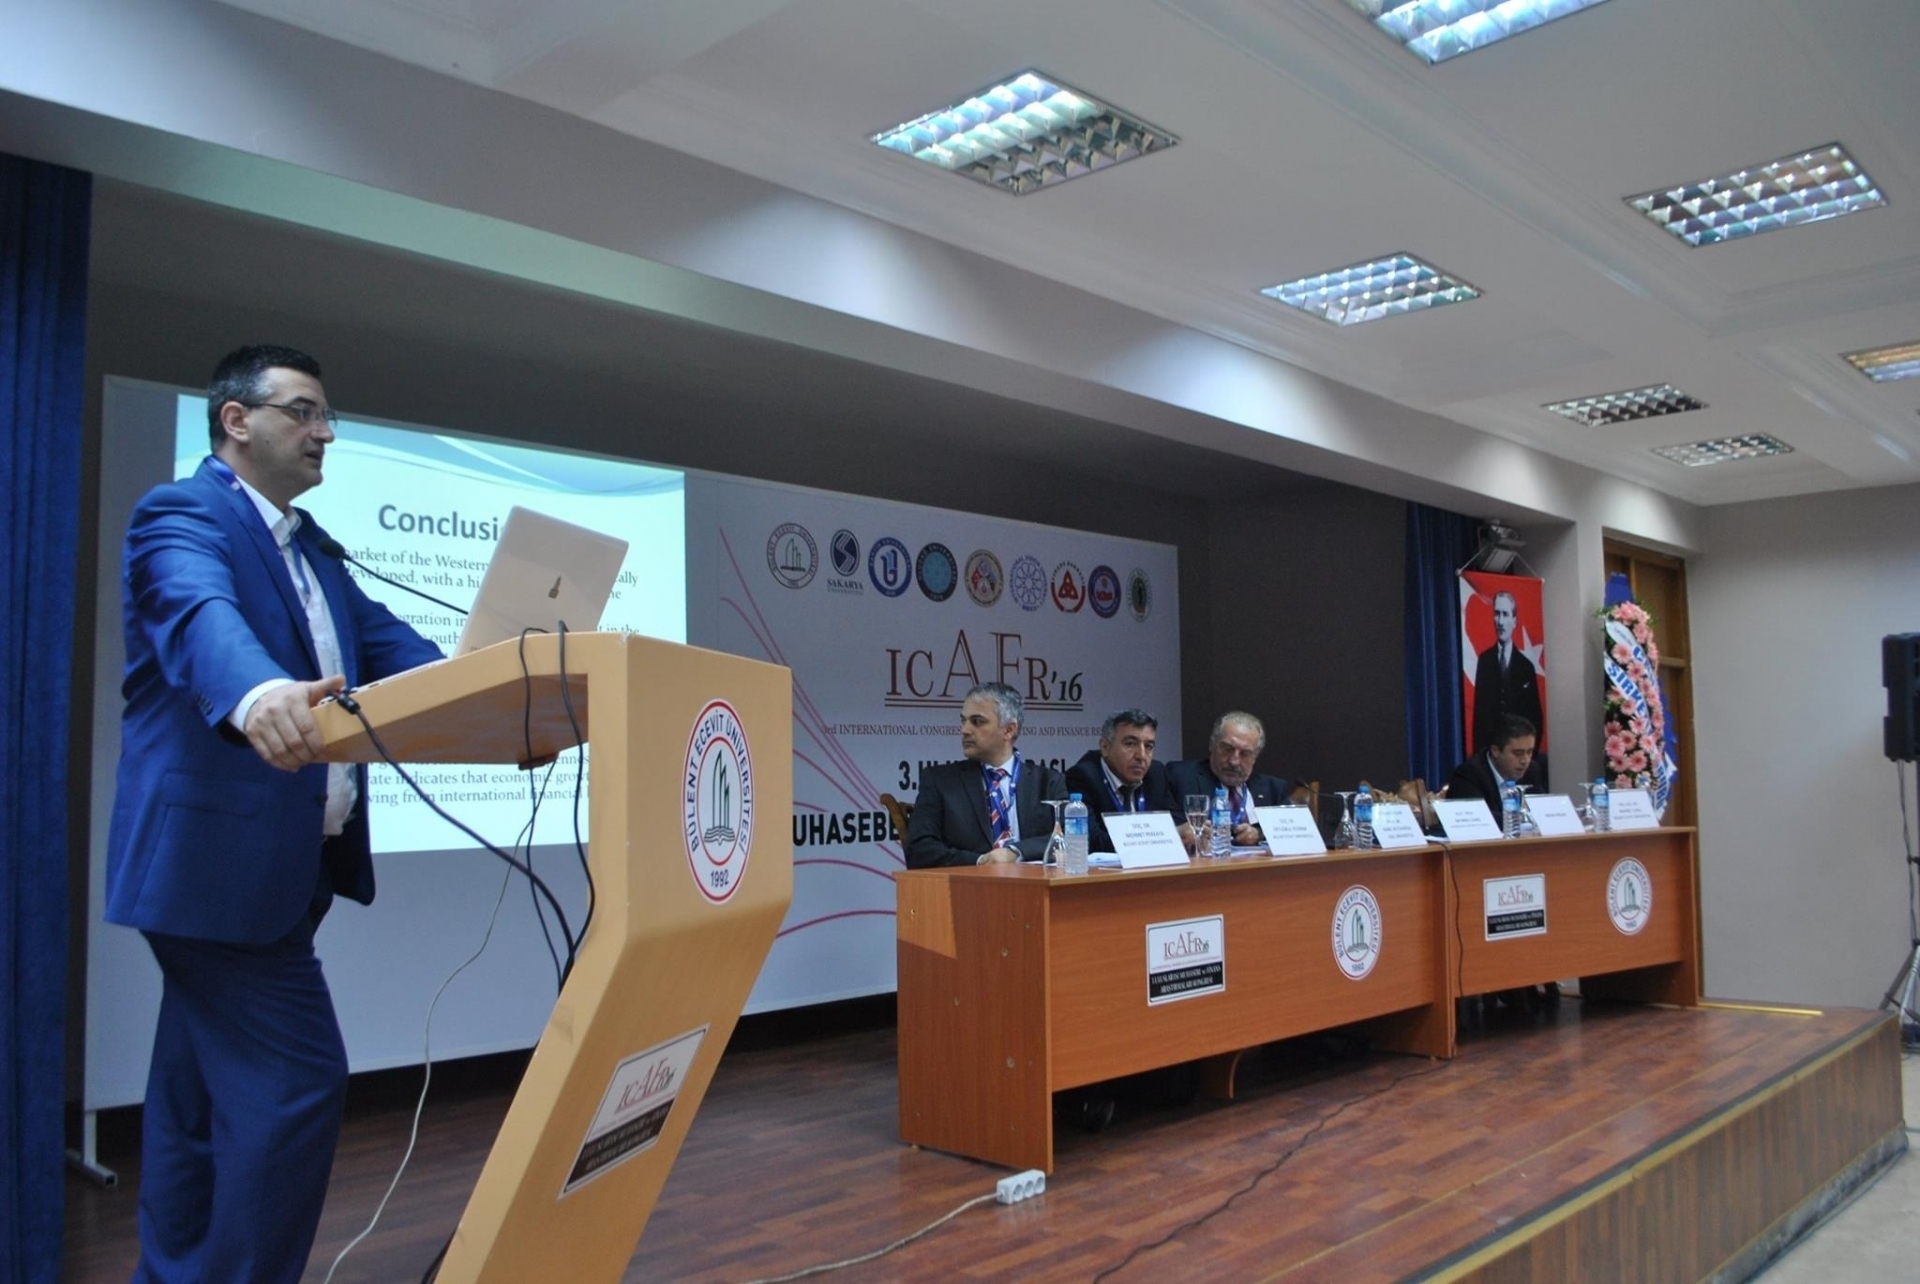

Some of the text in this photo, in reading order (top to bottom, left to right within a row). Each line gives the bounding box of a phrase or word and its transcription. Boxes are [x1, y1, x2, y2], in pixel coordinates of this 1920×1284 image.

[378, 504, 499, 541] Conclusi
[345, 546, 387, 563] arket
[391, 550, 408, 564] of
[408, 551, 432, 566] the
[423, 572, 453, 586] with
[456, 577, 464, 587] a
[467, 574, 480, 589] hi
[618, 571, 638, 587] ally
[839, 724, 918, 736] INTERNATIONAL
[919, 725, 962, 736] CONGRES
[1038, 726, 1056, 736] AND
[1057, 726, 1090, 737] FINANCE
[461, 769, 488, 784] that
[491, 771, 552, 784] economic
[686, 757, 700, 852] BÜLENT
[695, 709, 724, 756] ECEVİT
[368, 790, 399, 807] ving
[440, 787, 526, 802] international
[793, 811, 900, 846] UHASEBE
[710, 868, 729, 888] 1992
